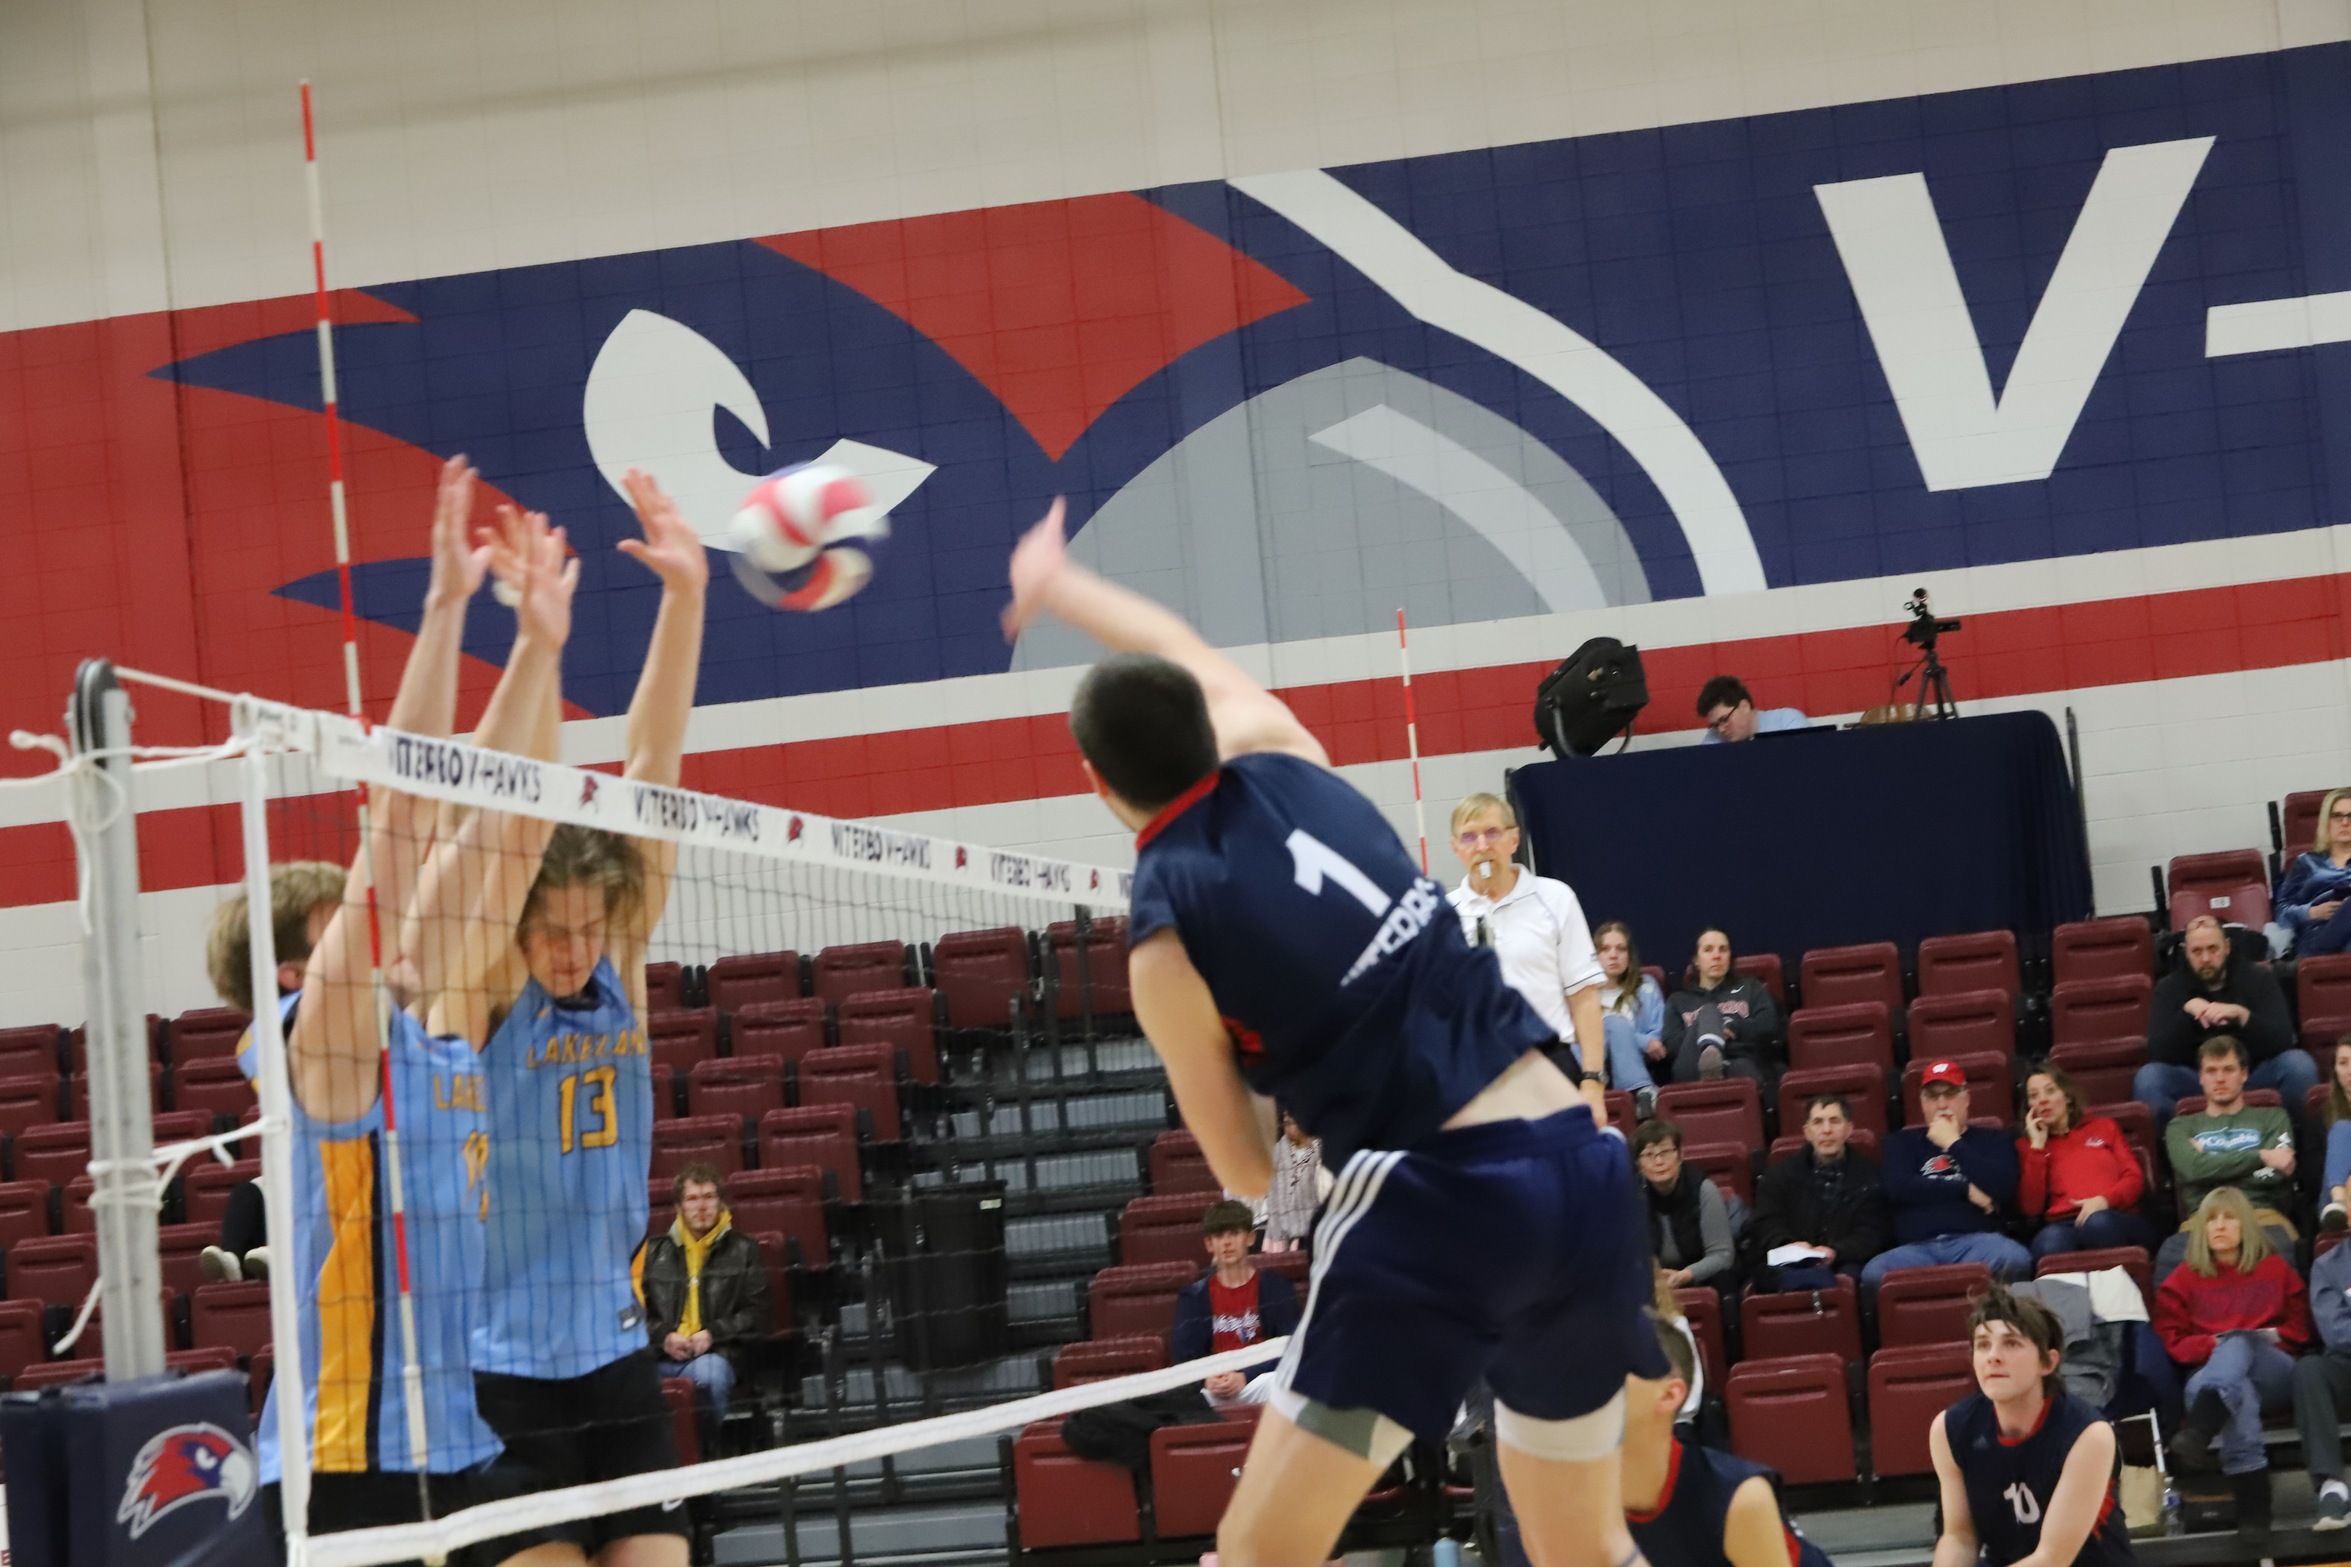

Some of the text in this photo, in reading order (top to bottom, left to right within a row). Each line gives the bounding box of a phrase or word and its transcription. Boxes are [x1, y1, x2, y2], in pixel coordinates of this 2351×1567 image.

[1285, 828, 1392, 917] 1
[559, 1064, 618, 1156] 13
[2003, 1482, 2041, 1525] 10
